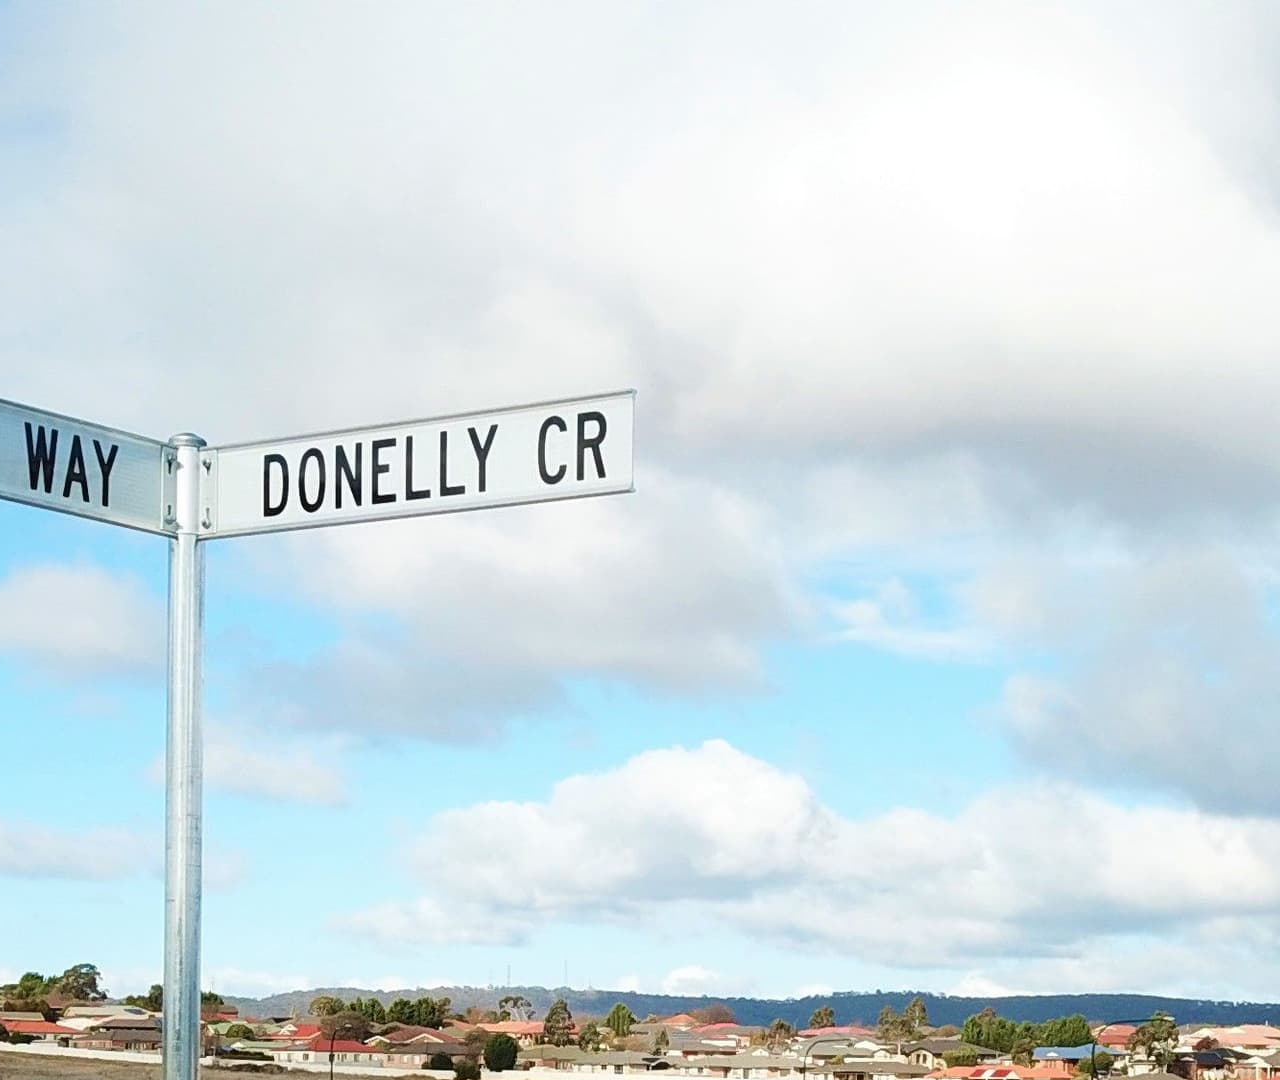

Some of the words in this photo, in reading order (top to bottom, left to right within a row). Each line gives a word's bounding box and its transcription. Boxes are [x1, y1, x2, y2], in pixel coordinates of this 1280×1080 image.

[24, 422, 118, 506] WAY
[263, 424, 498, 517] DONELLY
[537, 411, 607, 485] CR
